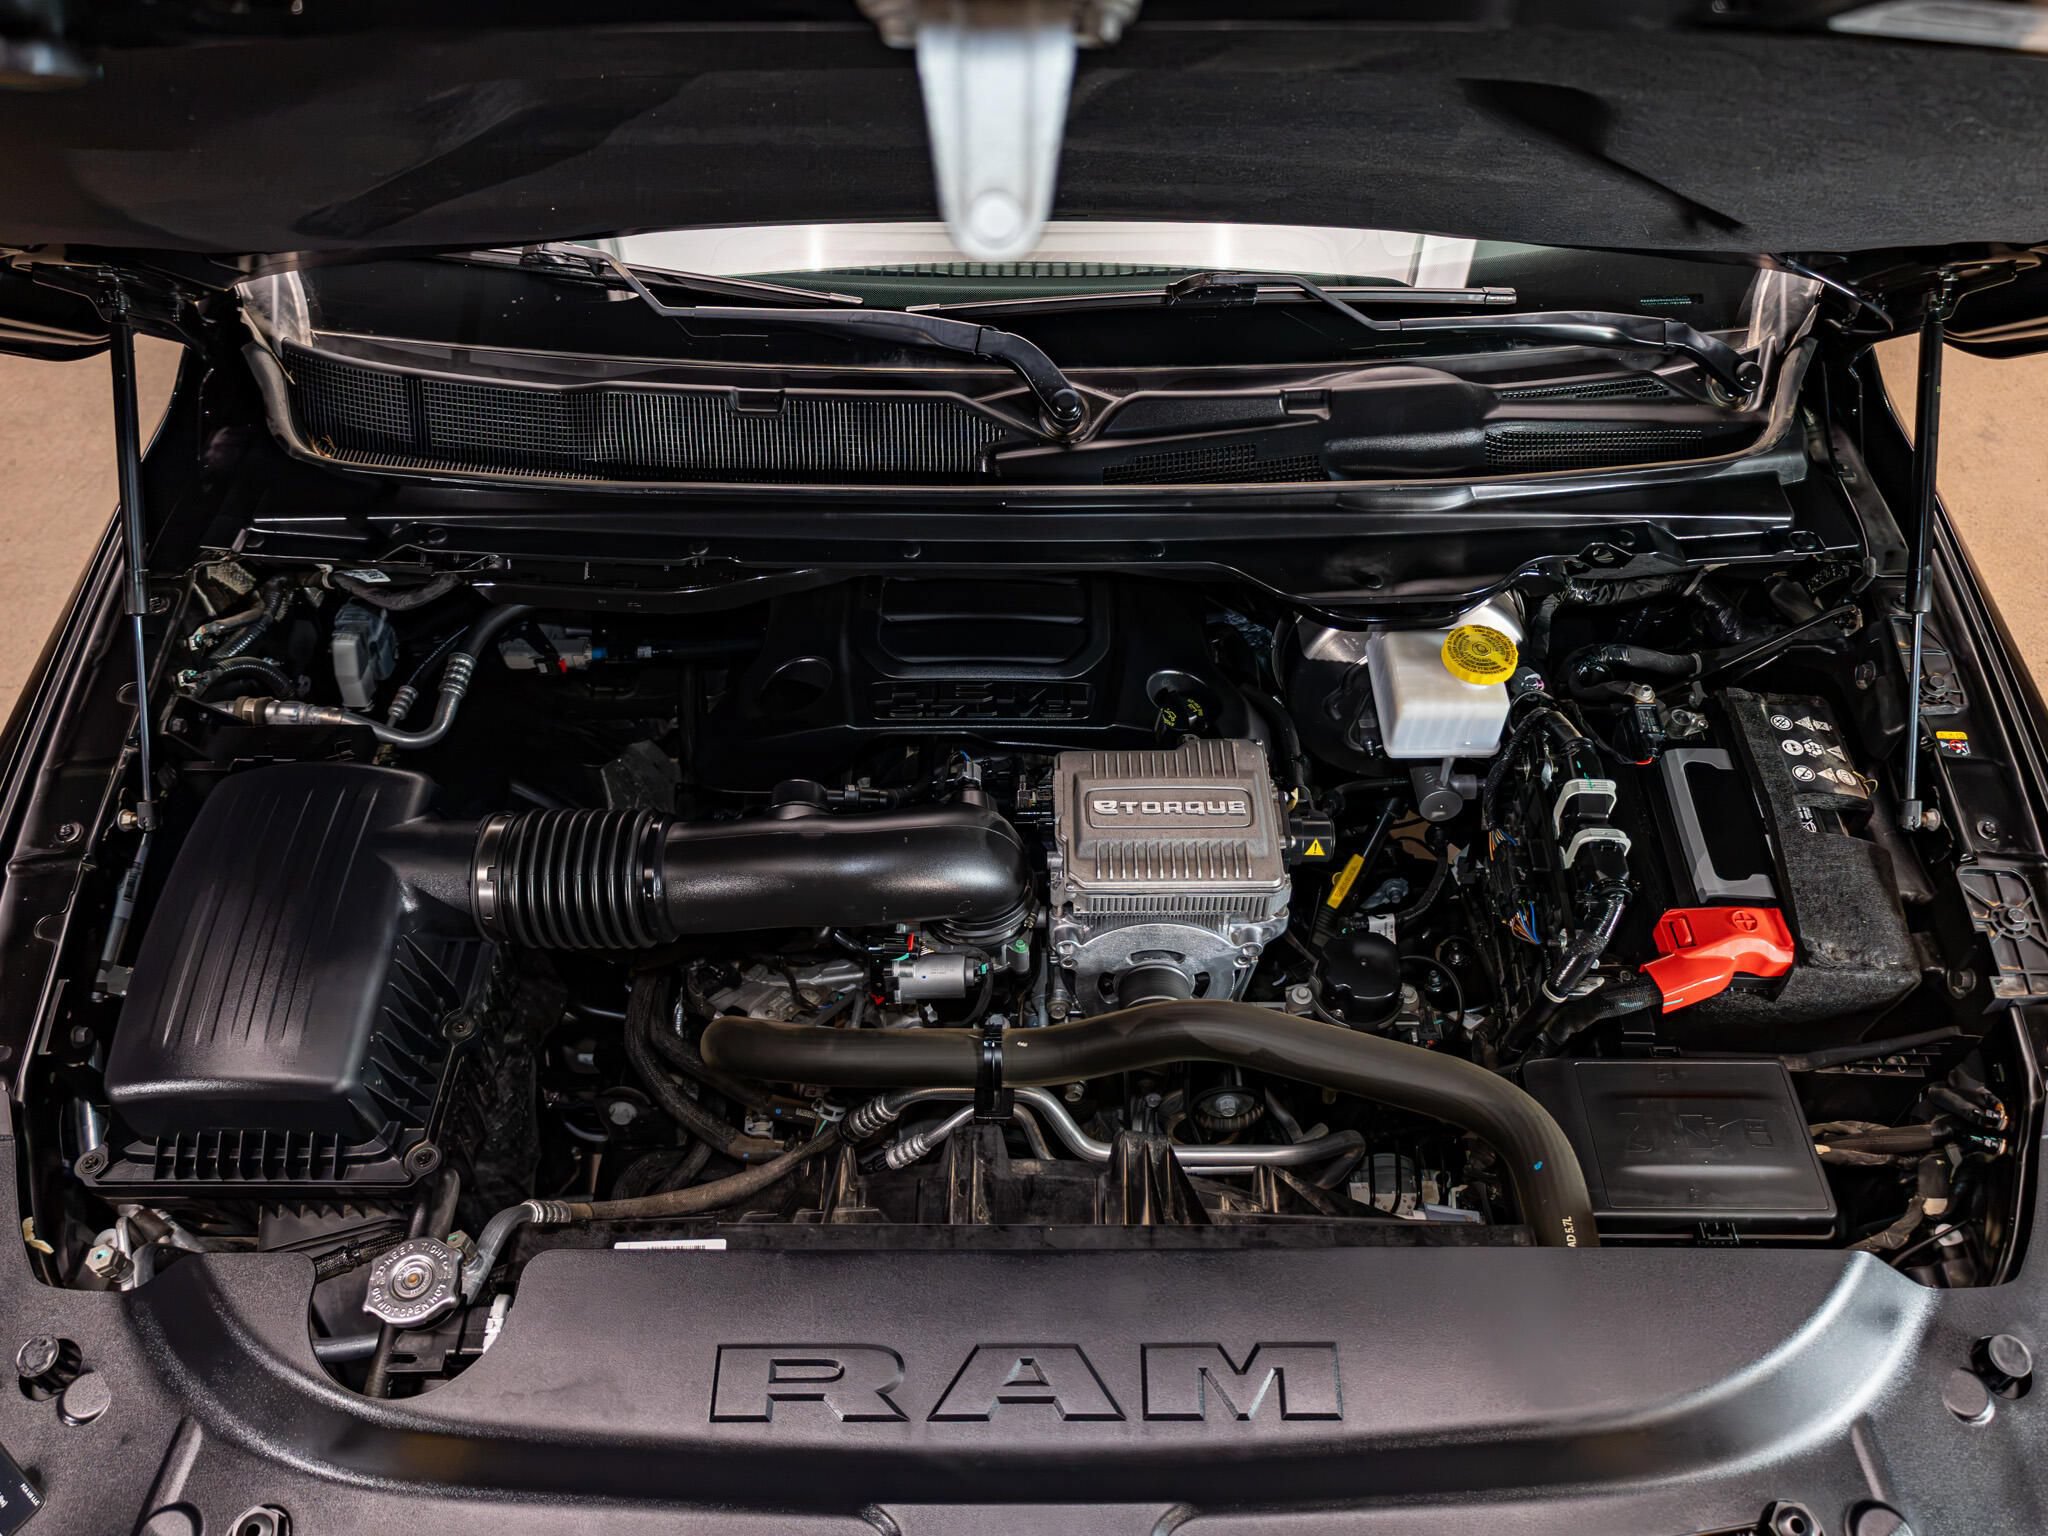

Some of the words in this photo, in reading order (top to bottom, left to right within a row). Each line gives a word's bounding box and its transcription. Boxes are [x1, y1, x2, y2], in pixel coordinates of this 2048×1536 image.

[385, 1243, 415, 1266] KEEP
[421, 1242, 448, 1260] TIGHT
[372, 1287, 382, 1302] DO
[377, 1302, 399, 1317] NOT
[399, 1303, 429, 1317] OPEN
[430, 1283, 447, 1304] HOT
[708, 1341, 1344, 1423] RAM
